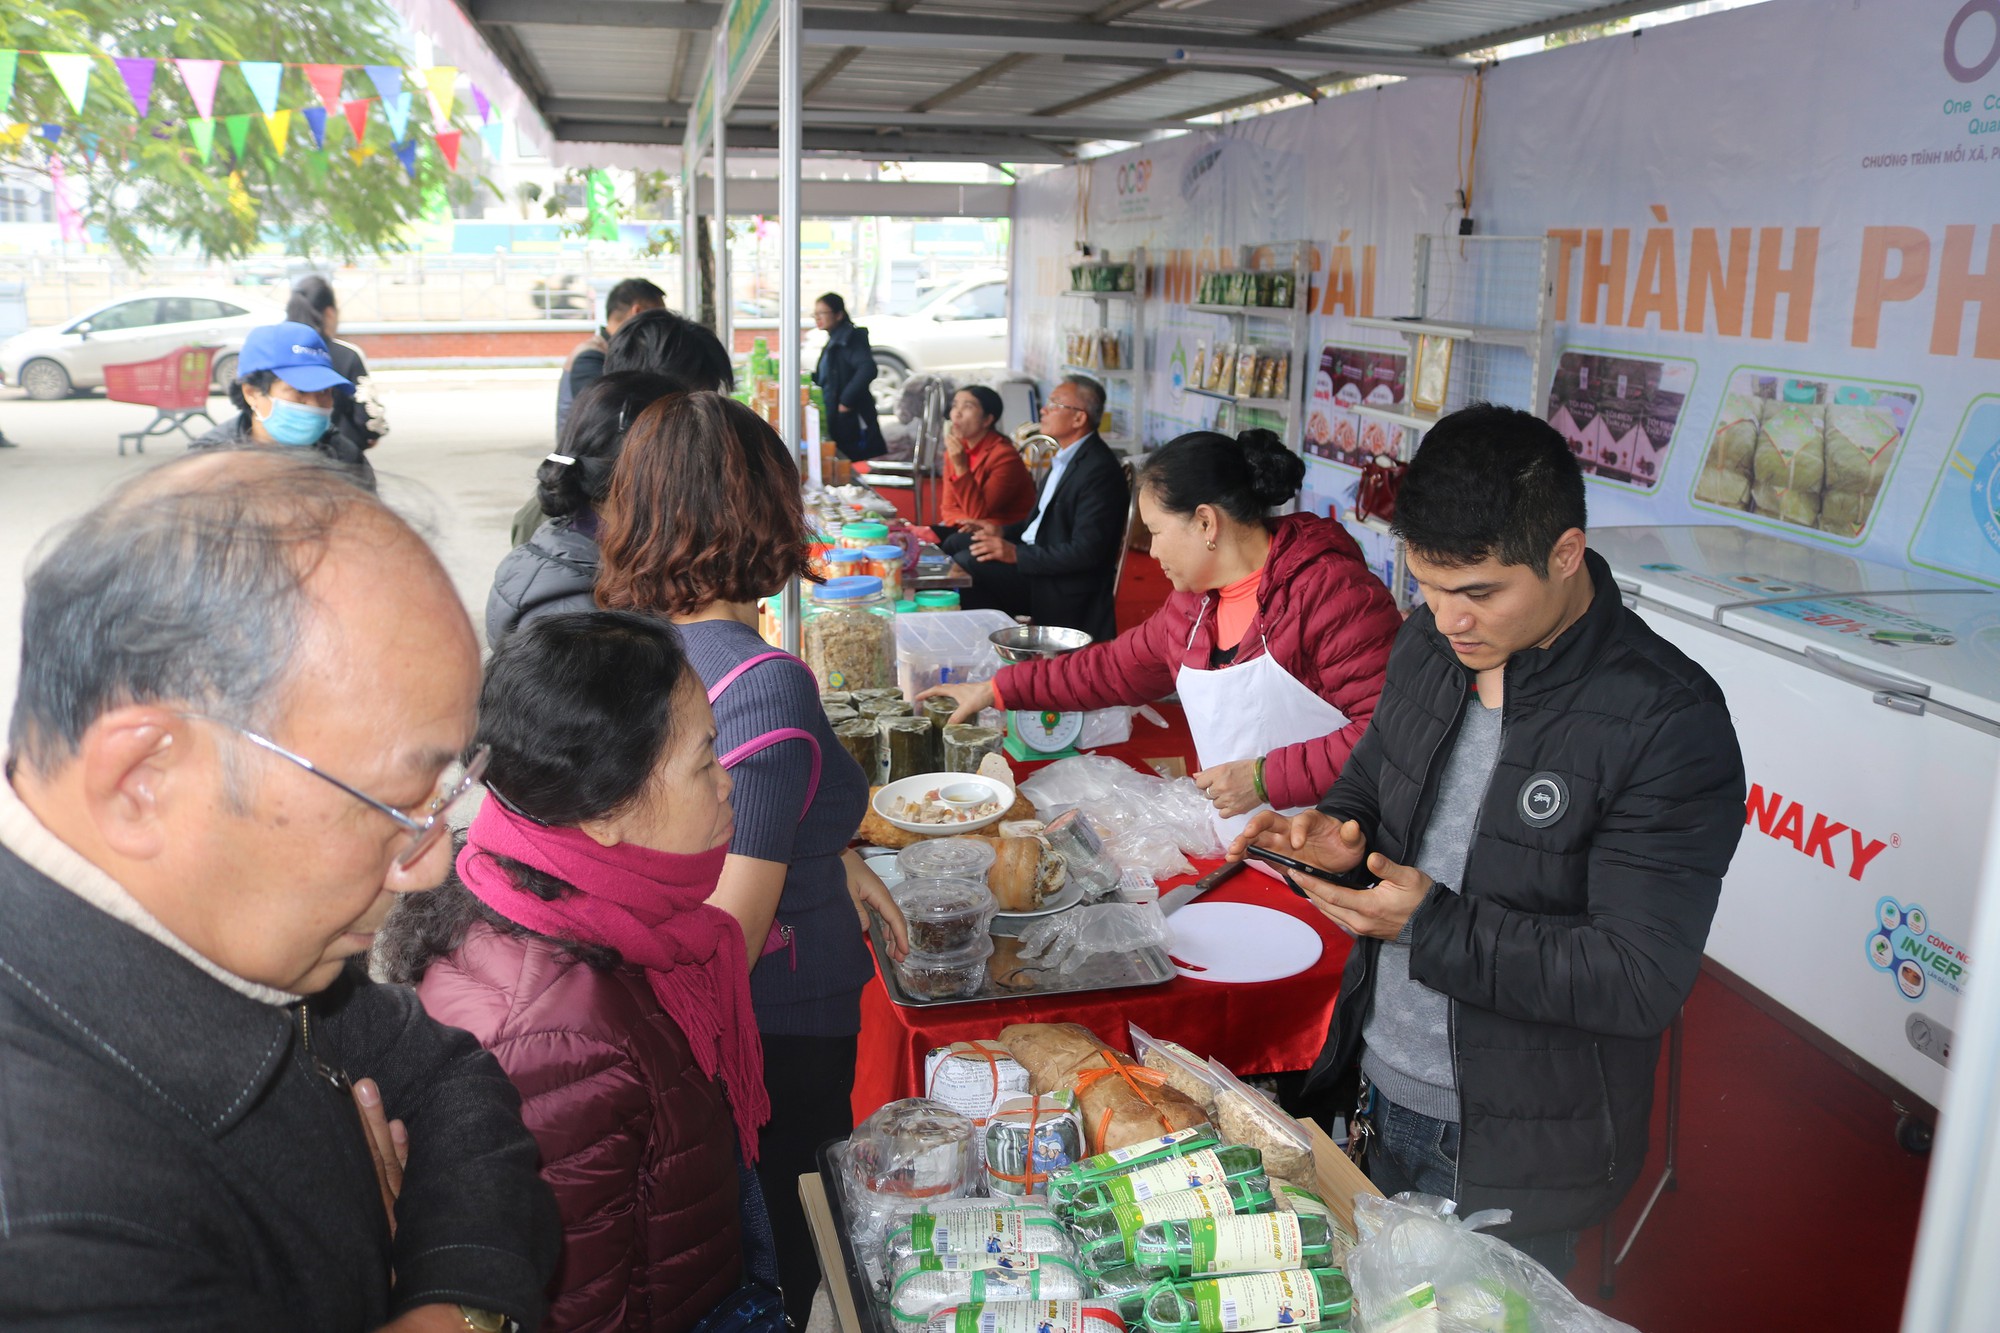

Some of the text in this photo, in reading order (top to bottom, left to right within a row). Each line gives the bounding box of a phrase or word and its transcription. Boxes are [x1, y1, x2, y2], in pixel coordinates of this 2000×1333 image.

[1943, 99, 1972, 115] One
[1862, 153, 1908, 168] CHƯƠNG
[1911, 149, 1941, 165] TRÌNH
[1547, 204, 1821, 344] THÀNH
[1801, 612, 1867, 634] 50%
